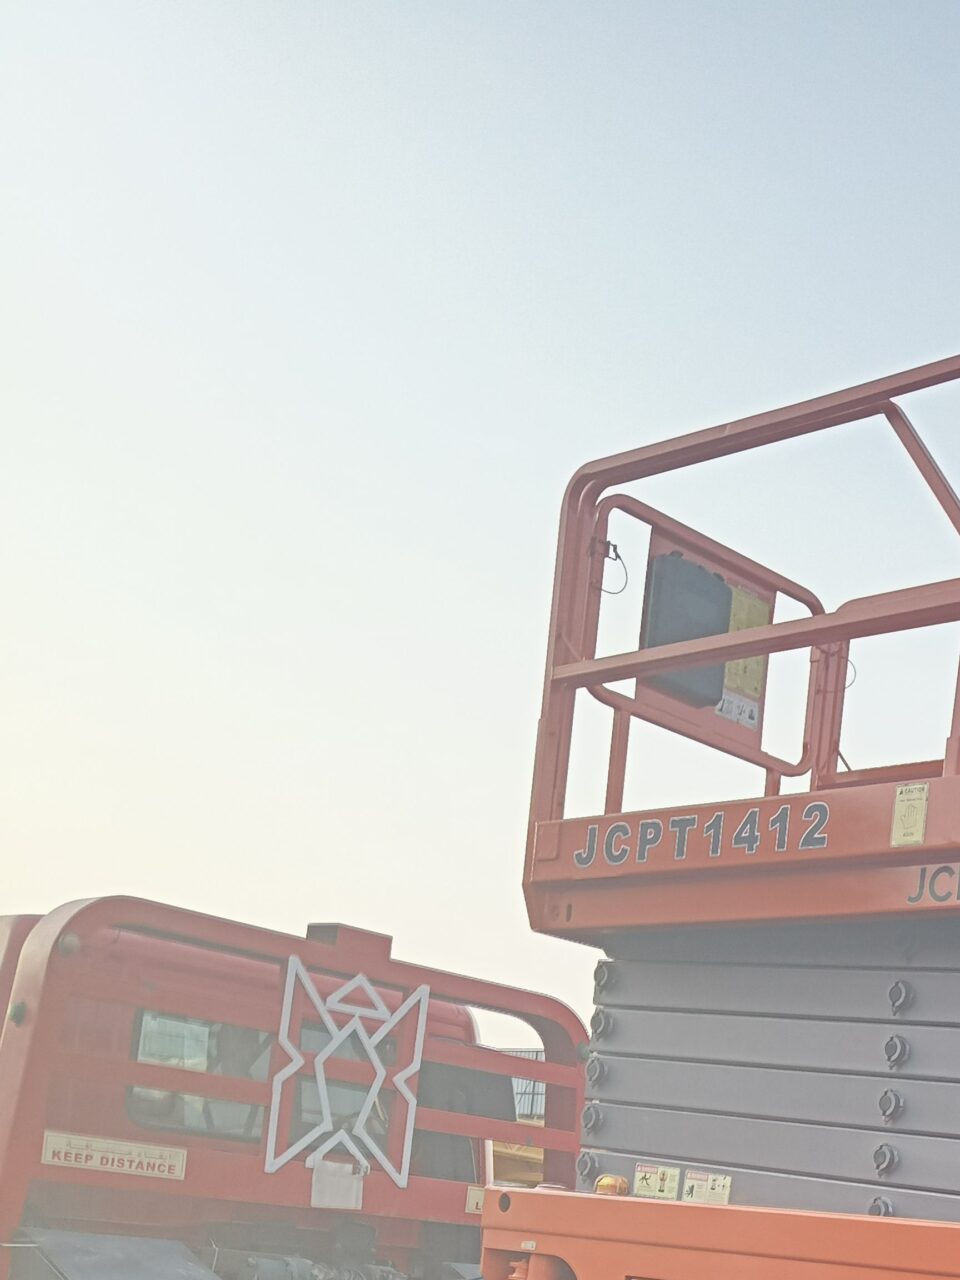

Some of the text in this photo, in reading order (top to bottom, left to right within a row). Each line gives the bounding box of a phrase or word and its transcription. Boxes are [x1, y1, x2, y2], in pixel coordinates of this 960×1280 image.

[573, 801, 830, 869] JCPT1412
[51, 1149, 177, 1175] KEEP DISTANCE
